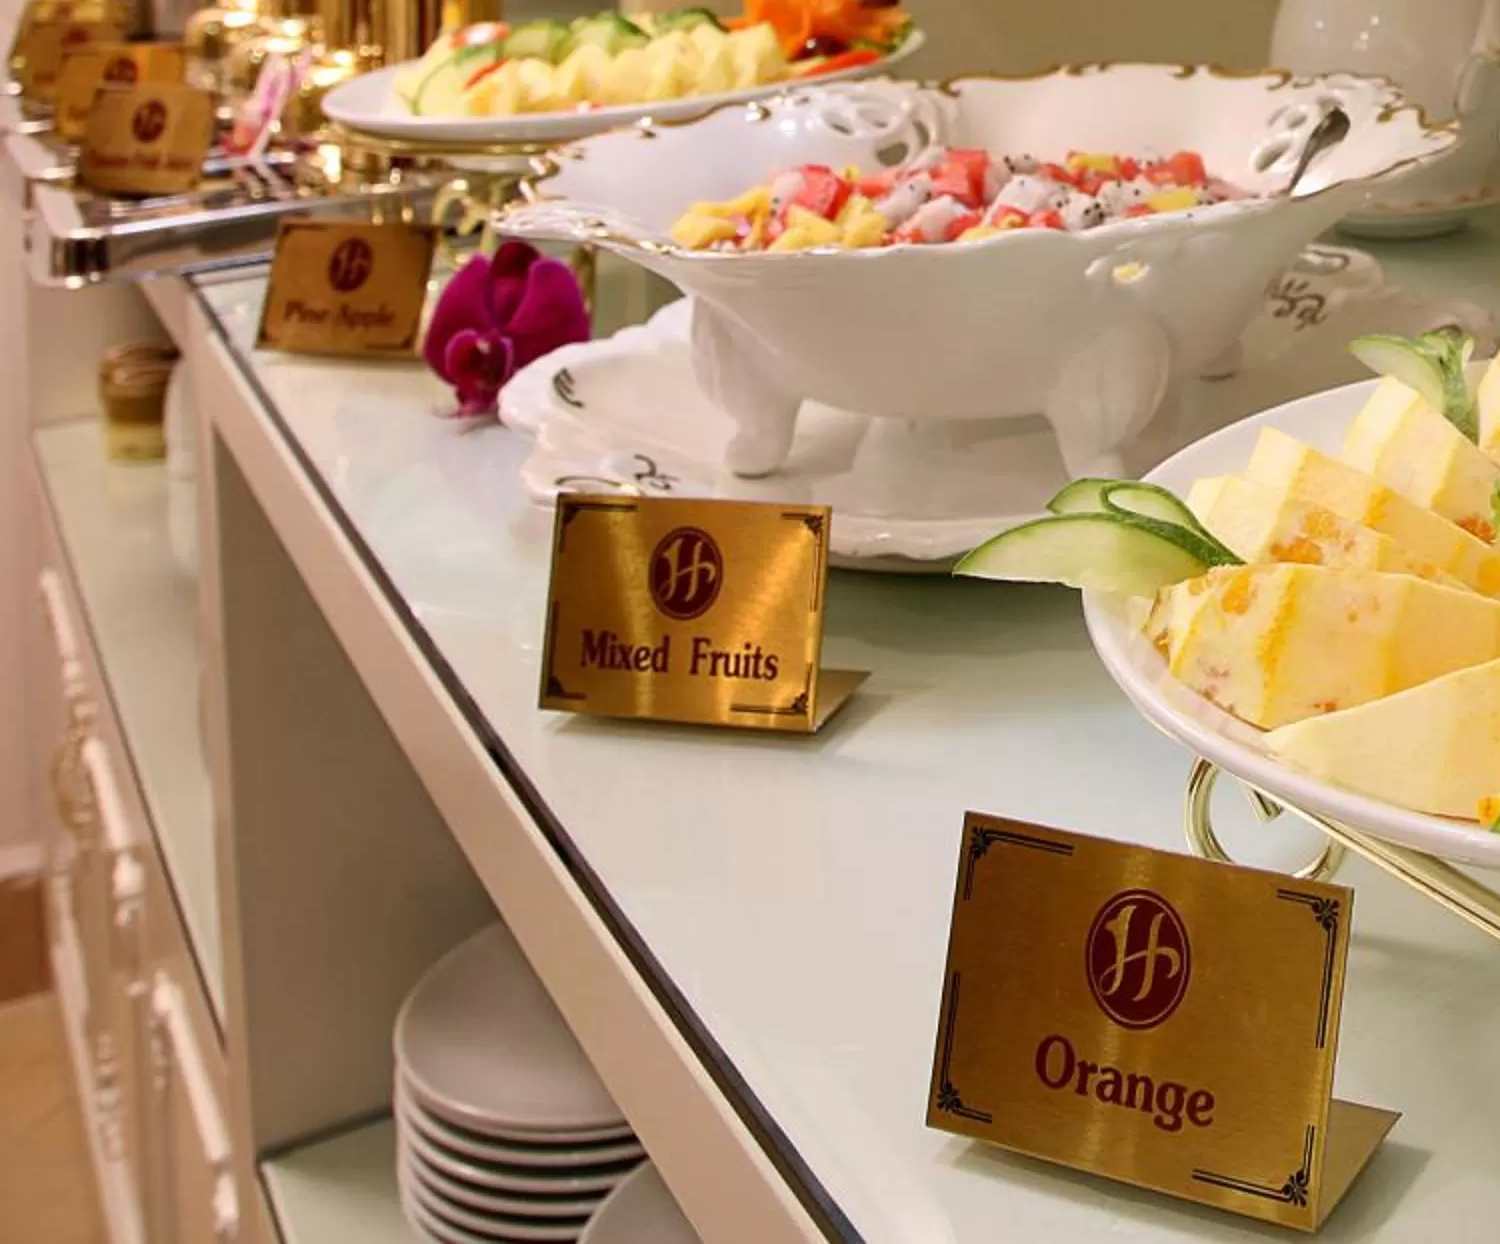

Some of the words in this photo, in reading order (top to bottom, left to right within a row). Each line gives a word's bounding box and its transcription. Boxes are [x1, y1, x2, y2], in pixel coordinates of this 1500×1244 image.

[579, 628, 671, 674] Mixed
[688, 637, 779, 681] Fruits
[1034, 1034, 1216, 1133] Orange
